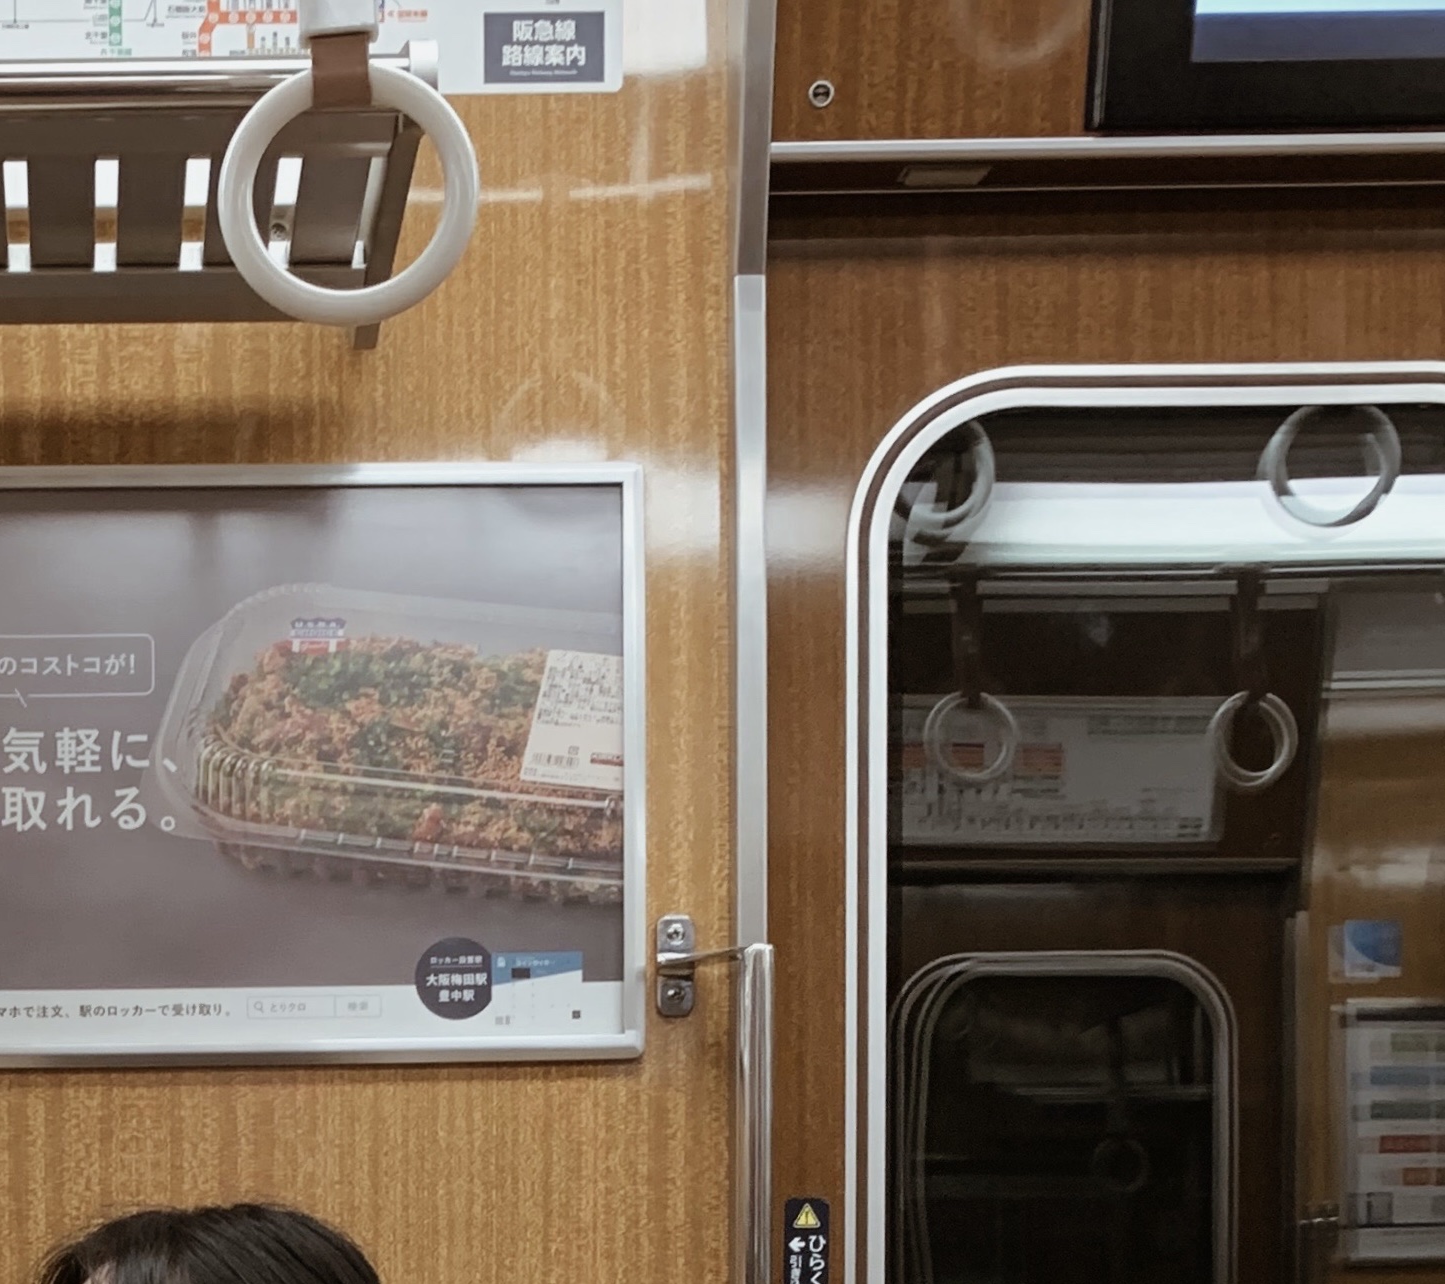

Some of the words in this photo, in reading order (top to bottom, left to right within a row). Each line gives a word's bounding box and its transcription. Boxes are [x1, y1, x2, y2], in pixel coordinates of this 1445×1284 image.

[513, 19, 576, 42] 阪急線
[502, 44, 586, 67] 路線案内
[425, 972, 488, 987] 大阪梅田駅
[438, 989, 476, 1002] 豊中駅
